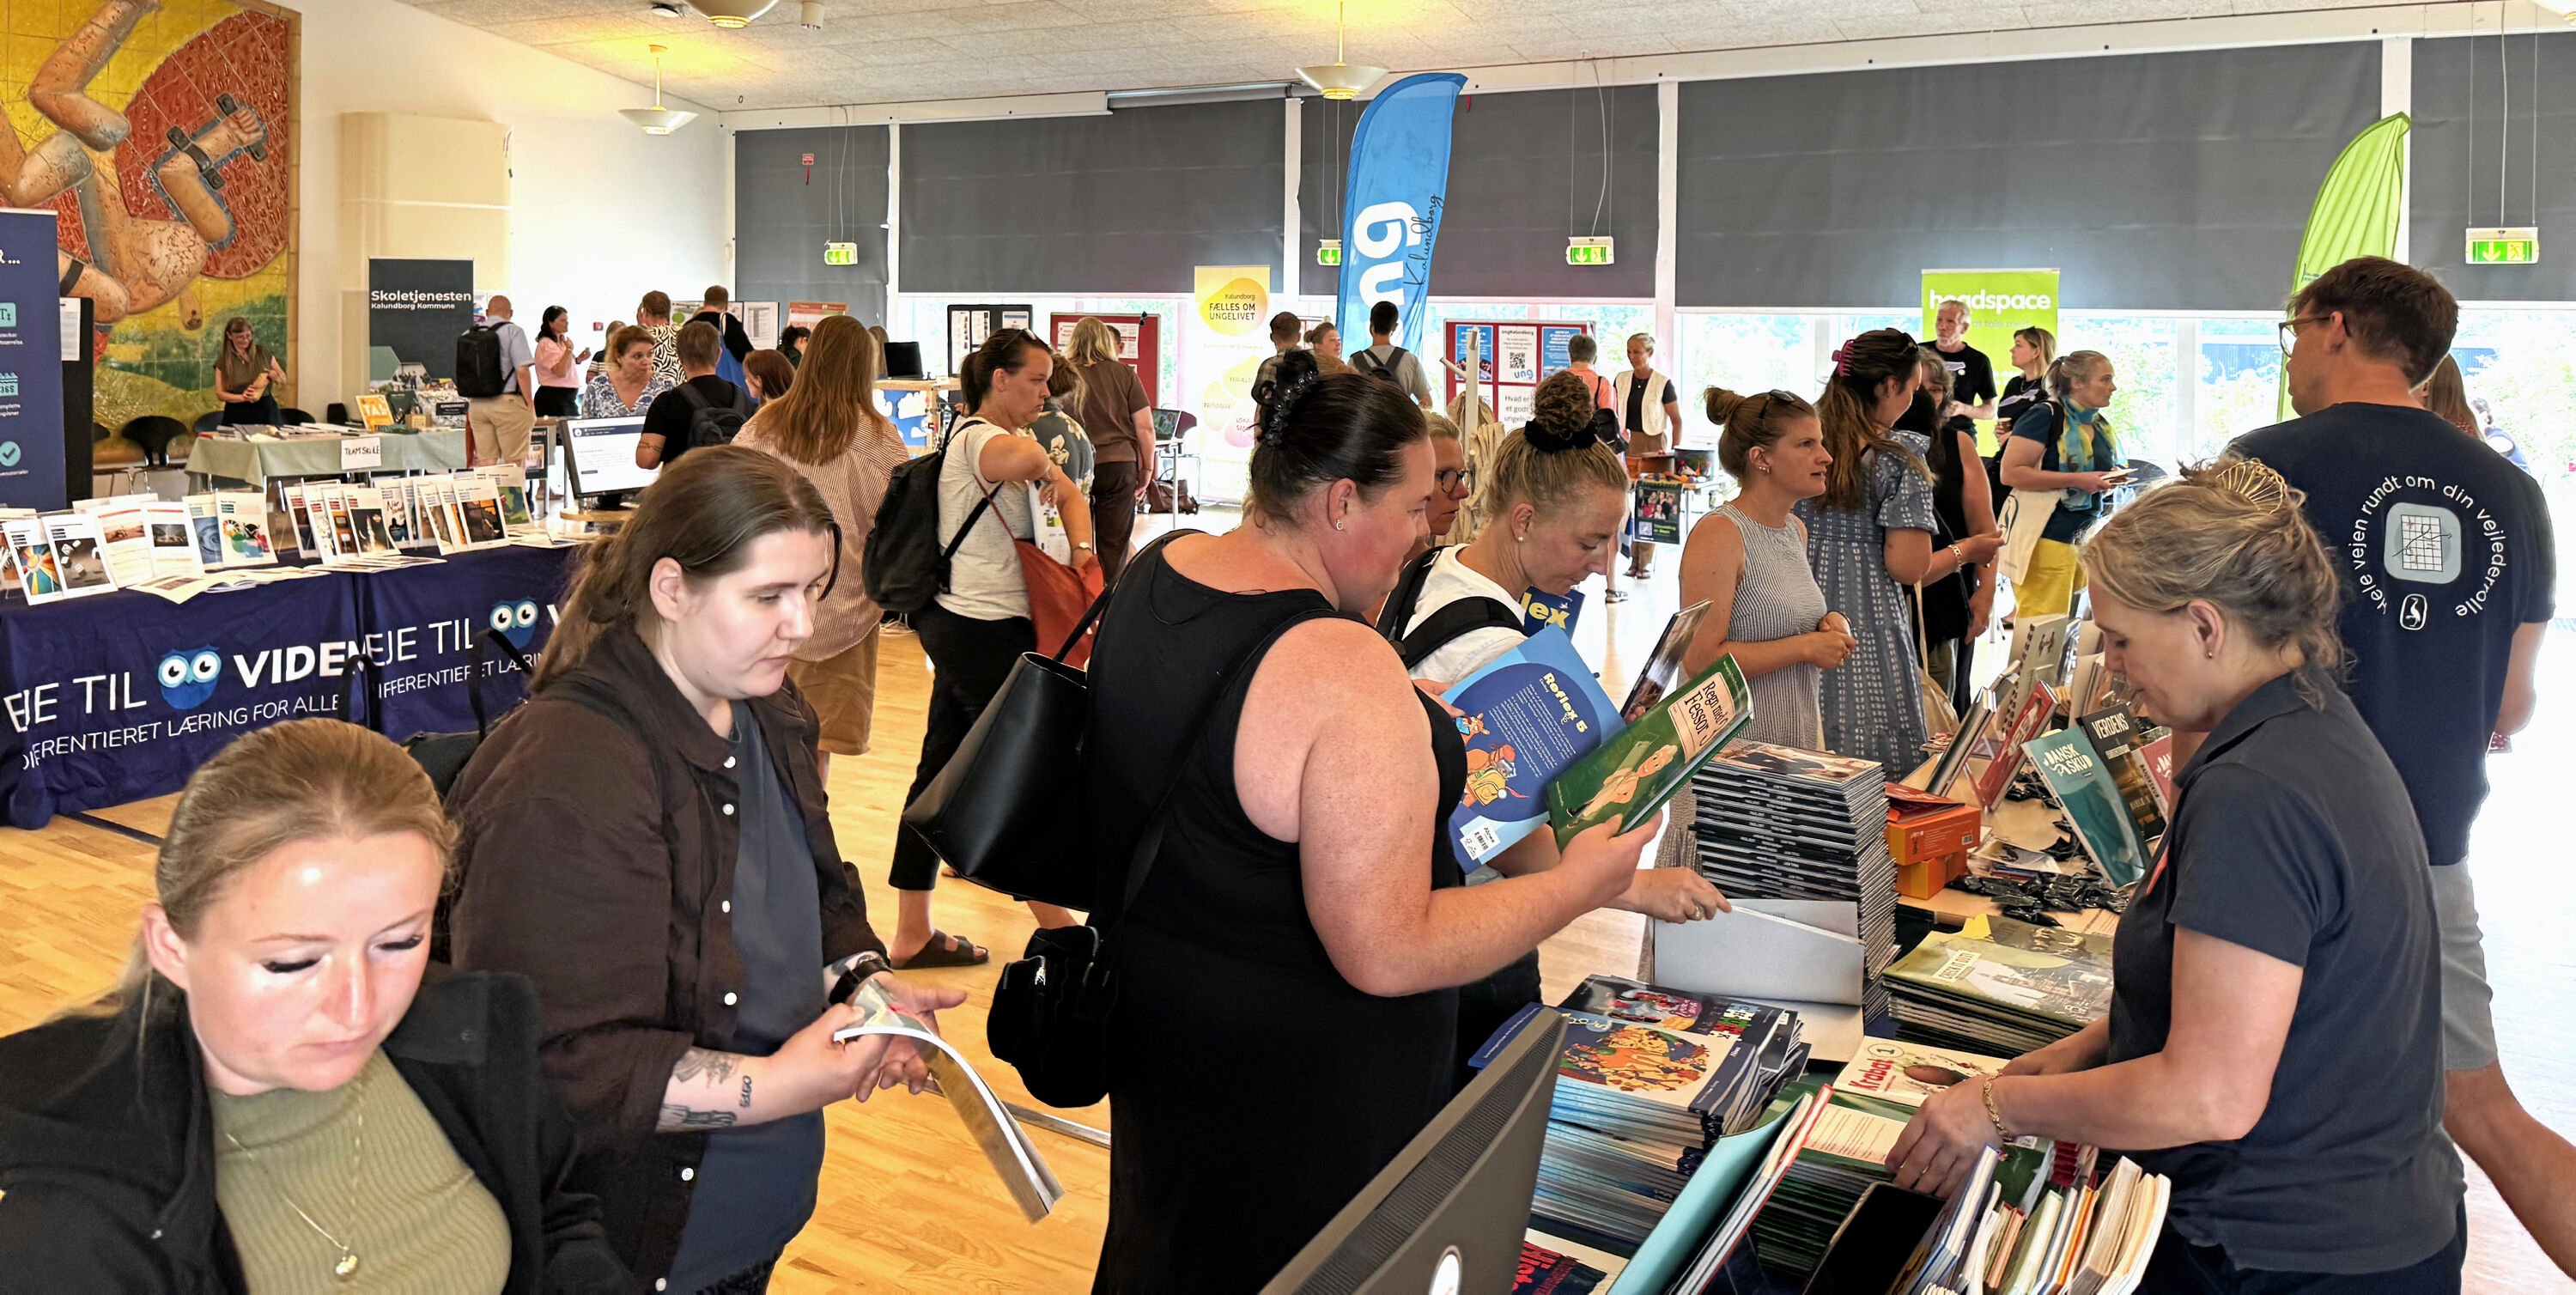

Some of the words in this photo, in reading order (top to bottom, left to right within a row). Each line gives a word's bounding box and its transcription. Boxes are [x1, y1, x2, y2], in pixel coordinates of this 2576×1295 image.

[1403, 194, 1444, 286] Kalundborg
[371, 290, 471, 303] Skoletjenesten
[371, 302, 416, 311] Kalundborg
[1514, 368, 1534, 380] ung
[2361, 475, 2403, 516] rundt
[2405, 475, 2436, 490] om
[2443, 483, 2475, 508] din
[2348, 519, 2368, 570] vejen
[2455, 508, 2507, 617] vejlederrolle
[1521, 592, 1571, 629] lex
[72, 672, 148, 714] TIL
[1703, 681, 1719, 708] Regn
[1713, 704, 1728, 725] med
[167, 708, 248, 737] LÆRING
[253, 699, 289, 721] FOR
[1685, 690, 1710, 734] Fessor
[2091, 712, 2129, 739] VERDENS
[1848, 1058, 1895, 1091] Krabat
